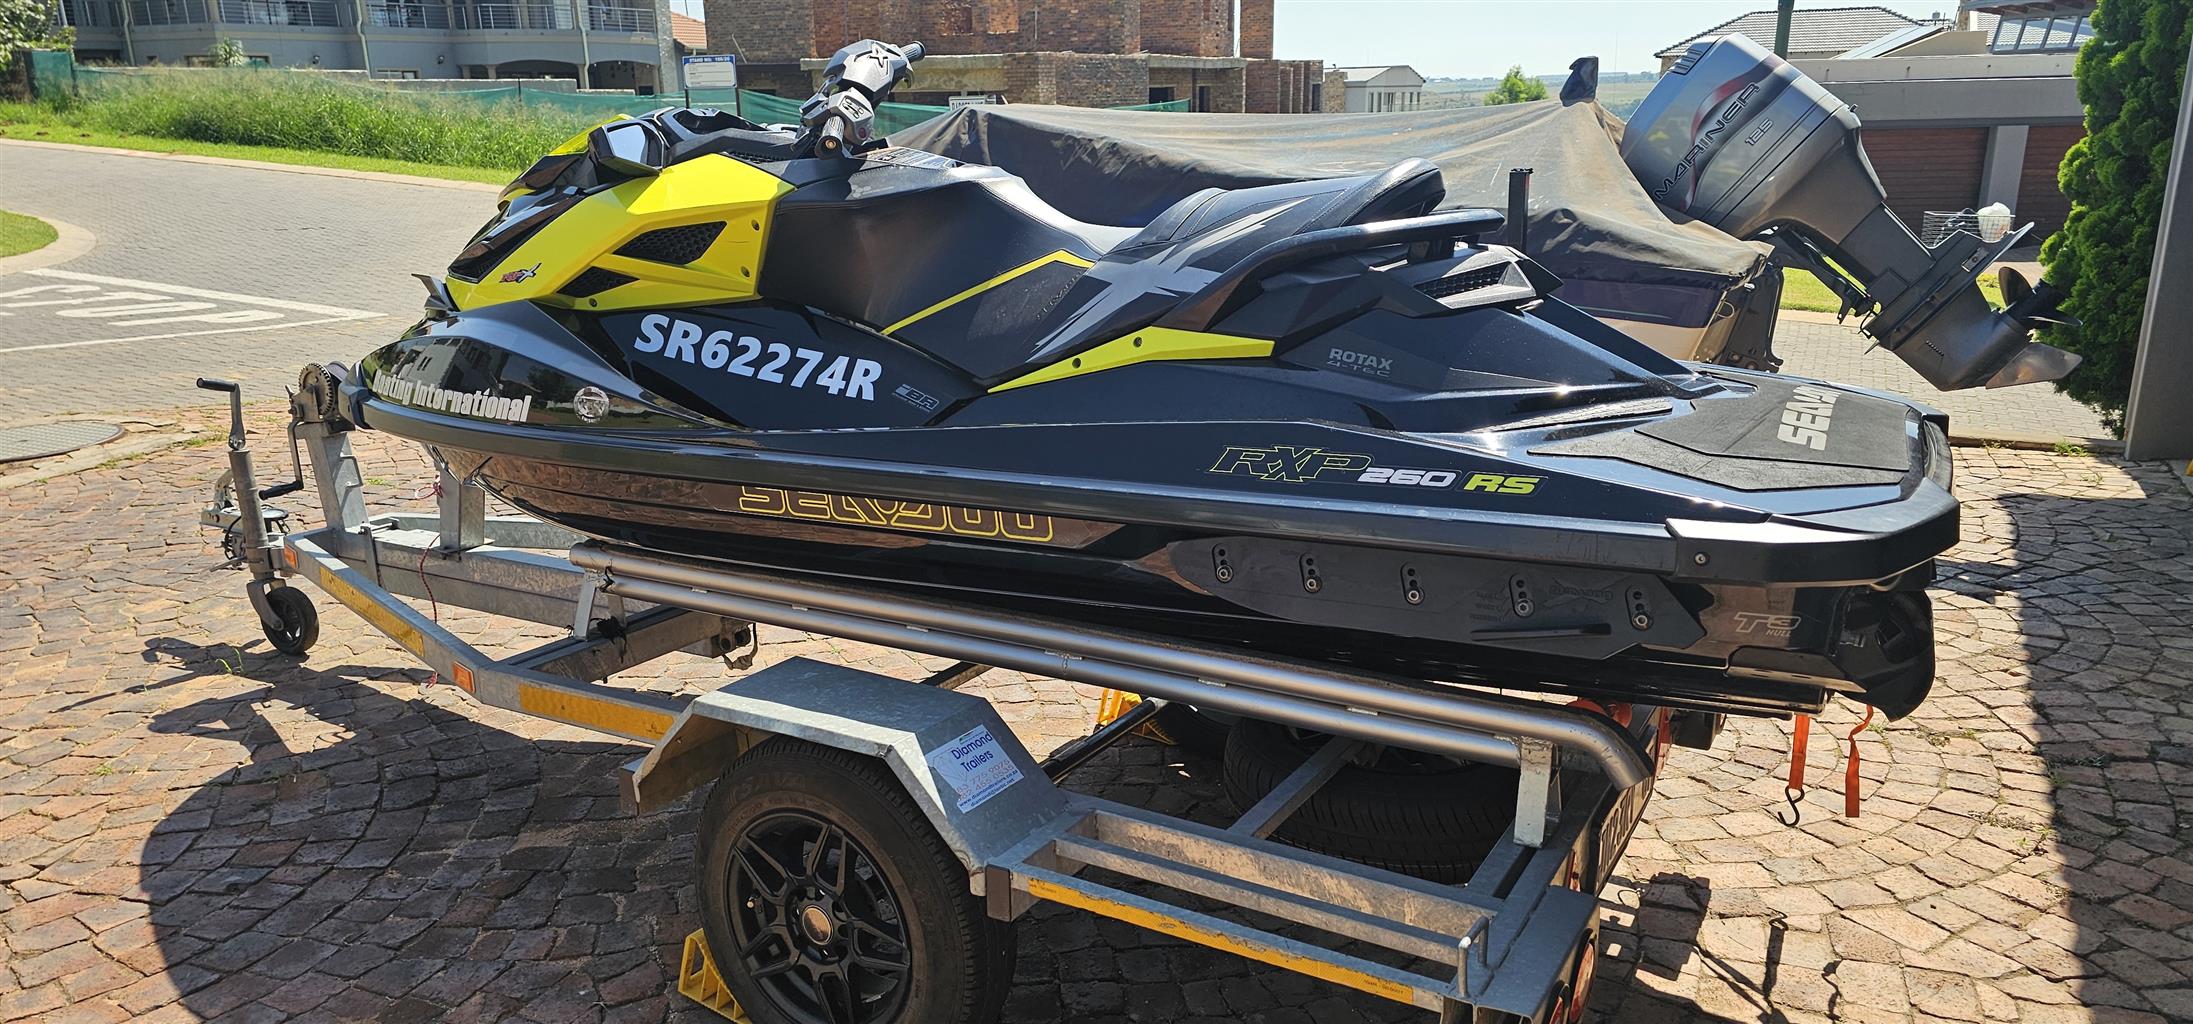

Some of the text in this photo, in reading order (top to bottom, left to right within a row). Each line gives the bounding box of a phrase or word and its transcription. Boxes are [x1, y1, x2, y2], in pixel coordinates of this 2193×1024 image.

[1653, 81, 1760, 200] MARINER
[1744, 118, 1774, 147] 125
[633, 313, 883, 401] SR62274R
[1328, 348, 1393, 371] ROTAX
[372, 369, 533, 423] Boating International
[1208, 446, 1540, 495] RXP 260 RS
[1733, 612, 1802, 633] T3
[1765, 629, 1792, 638] HULL
[951, 731, 993, 760] Diamond
[960, 750, 994, 772] Trailers
